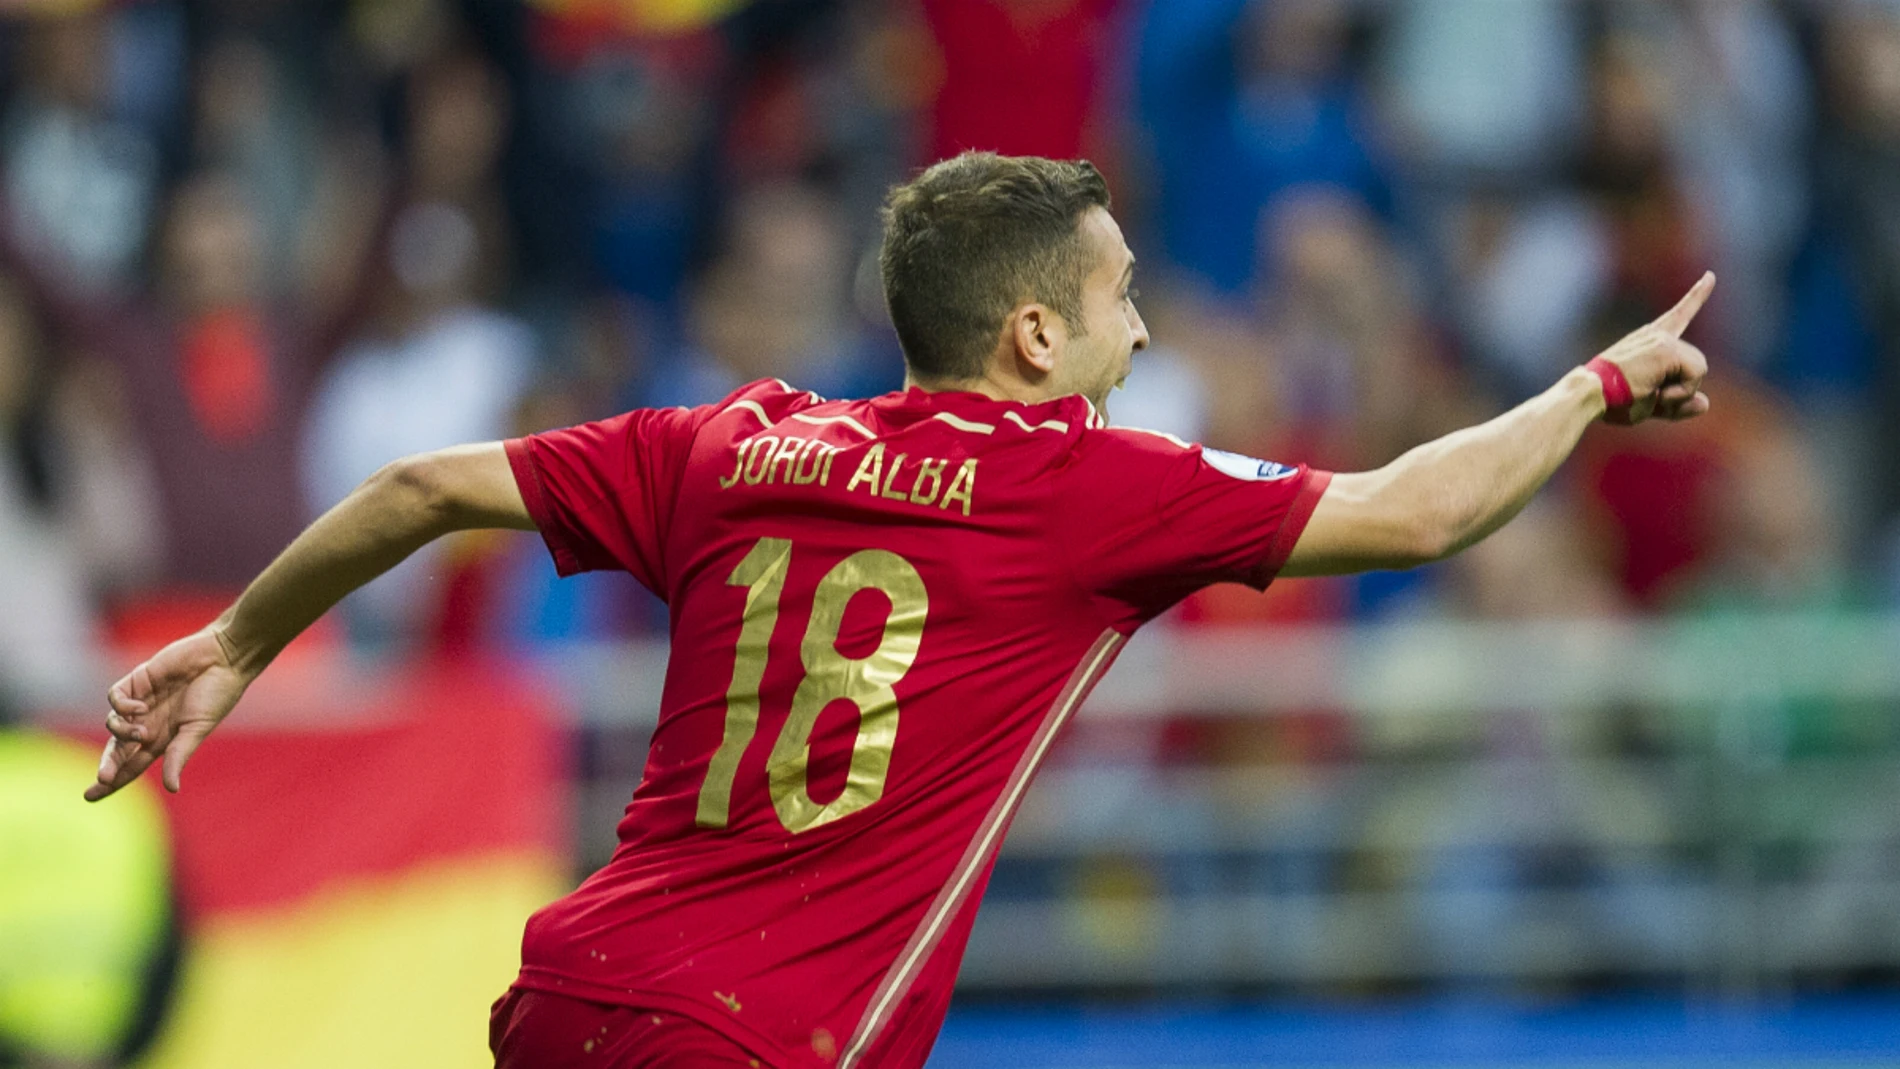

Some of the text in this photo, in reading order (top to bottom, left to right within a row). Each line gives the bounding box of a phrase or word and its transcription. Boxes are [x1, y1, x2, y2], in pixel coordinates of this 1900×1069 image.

[719, 436, 979, 517] JORDI ALBA
[695, 536, 929, 835] 18
